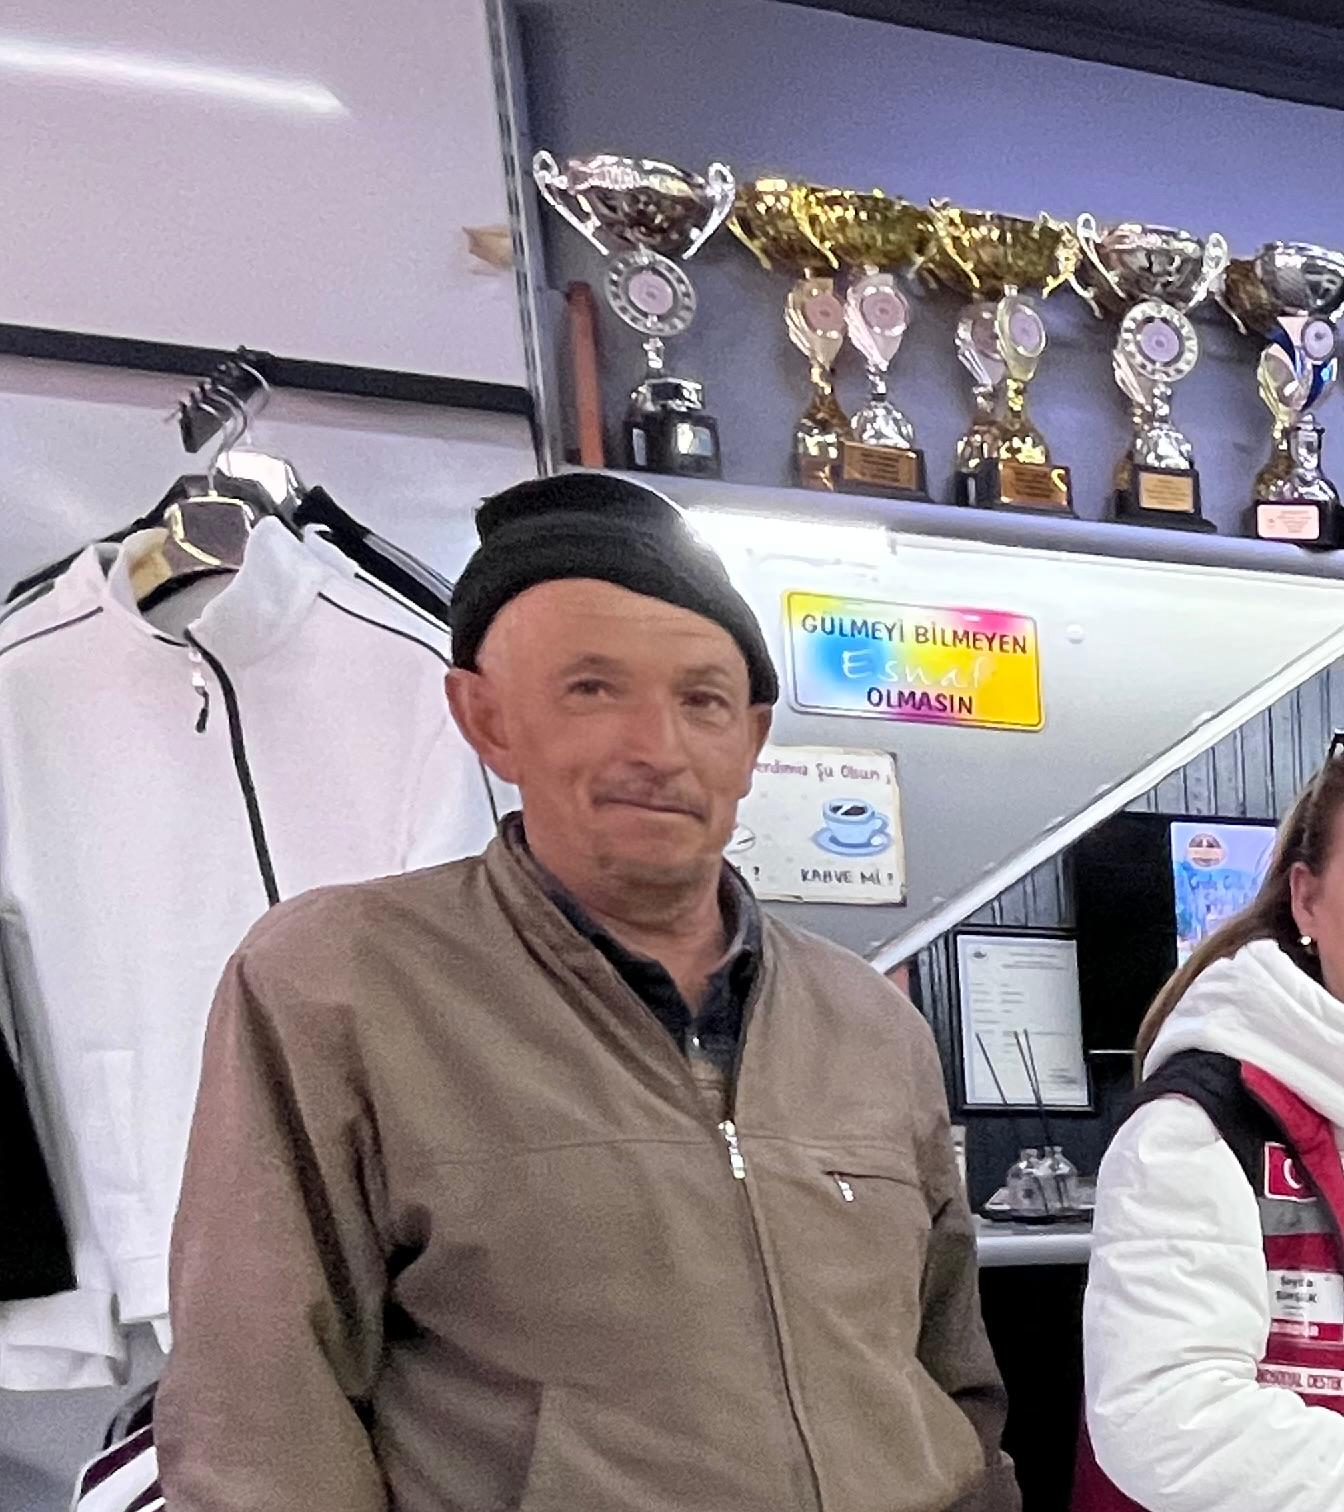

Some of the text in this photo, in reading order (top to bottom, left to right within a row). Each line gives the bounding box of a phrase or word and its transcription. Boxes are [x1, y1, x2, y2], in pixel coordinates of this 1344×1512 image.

[914, 621, 1028, 654] BİLMEYEN
[842, 649, 990, 689] Esnaf
[866, 686, 974, 715] OLMASIN
[800, 868, 853, 884] KAHVE
